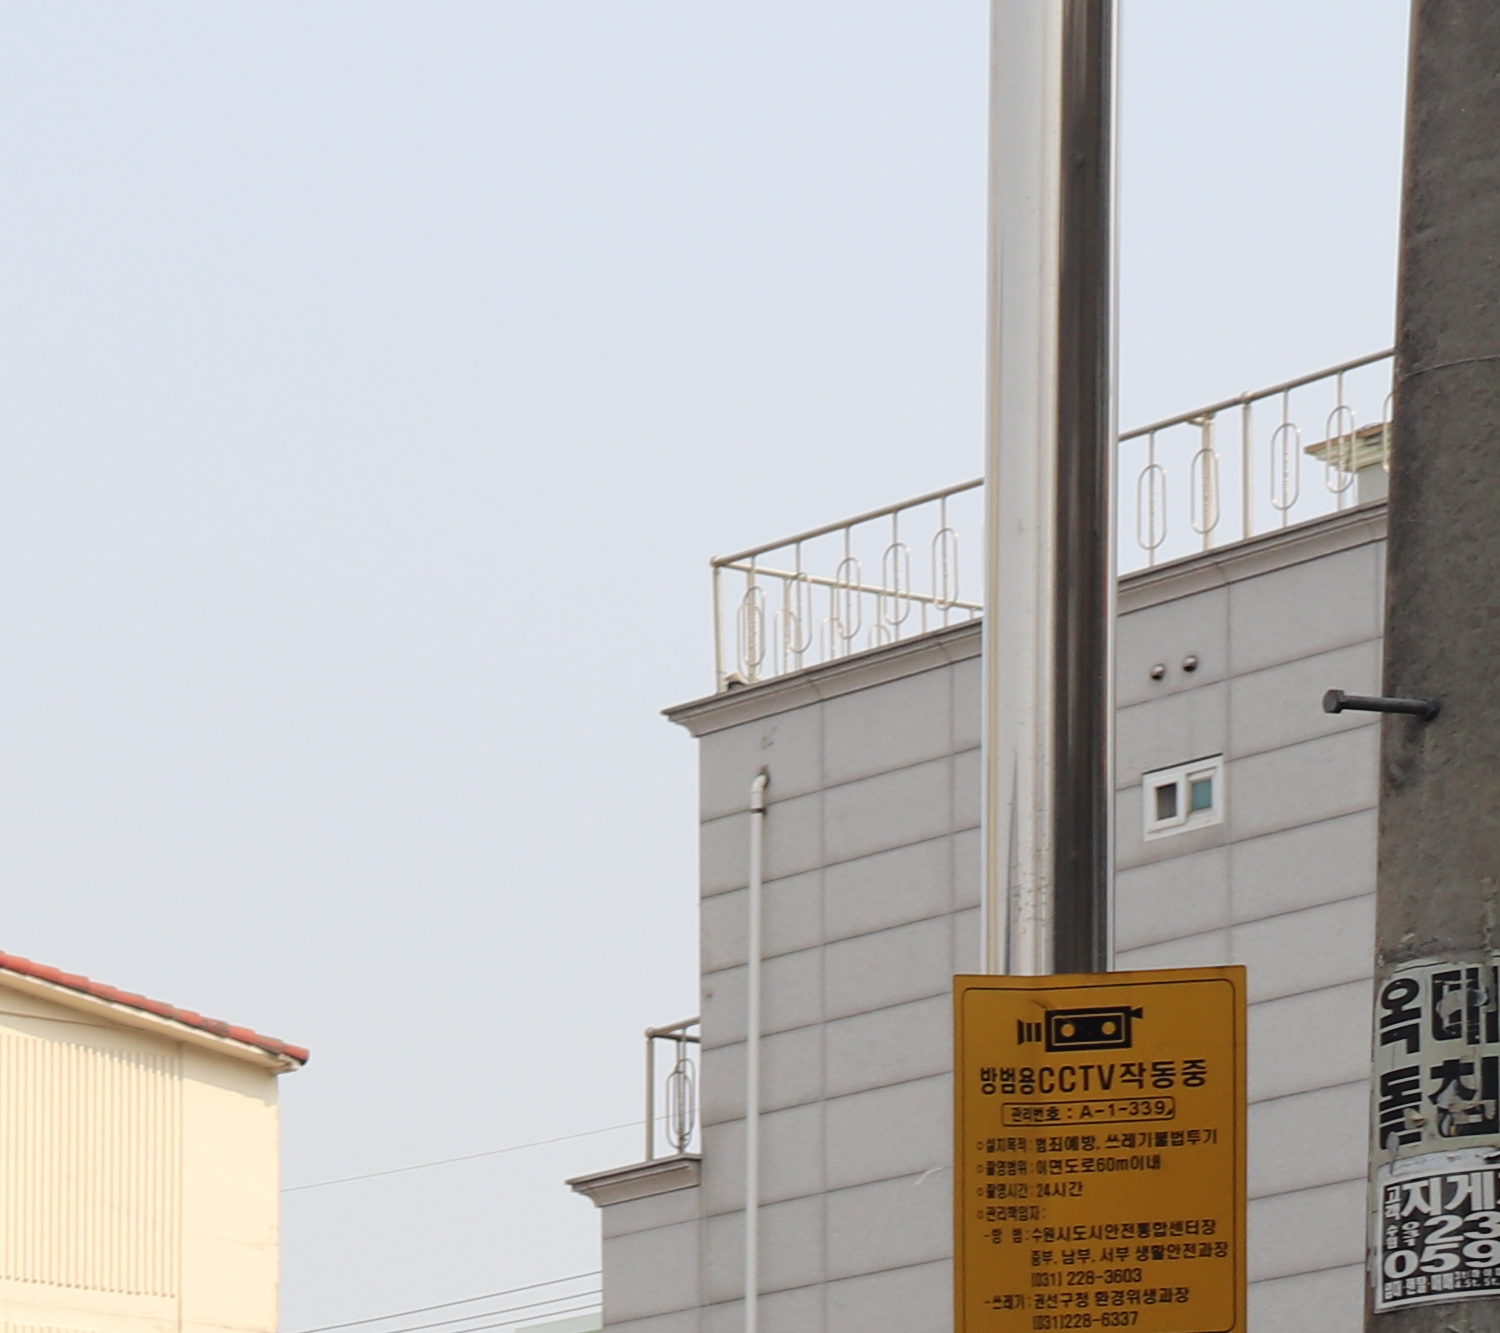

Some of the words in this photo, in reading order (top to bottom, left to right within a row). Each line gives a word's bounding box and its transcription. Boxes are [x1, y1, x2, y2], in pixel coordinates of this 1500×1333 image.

[980, 1059, 1207, 1096] 방범용CCTV작동중
[1011, 1107, 1060, 1122] 관리번호
[1079, 1101, 1166, 1119] A-1-339
[1401, 1170, 1500, 1217] 지게
[1100, 1246, 1130, 1262] 서부
[1067, 1268, 1142, 1286] 228-3603
[1034, 1292, 1090, 1309] 권선구청
[1094, 1287, 1189, 1307] 환경위생과장
